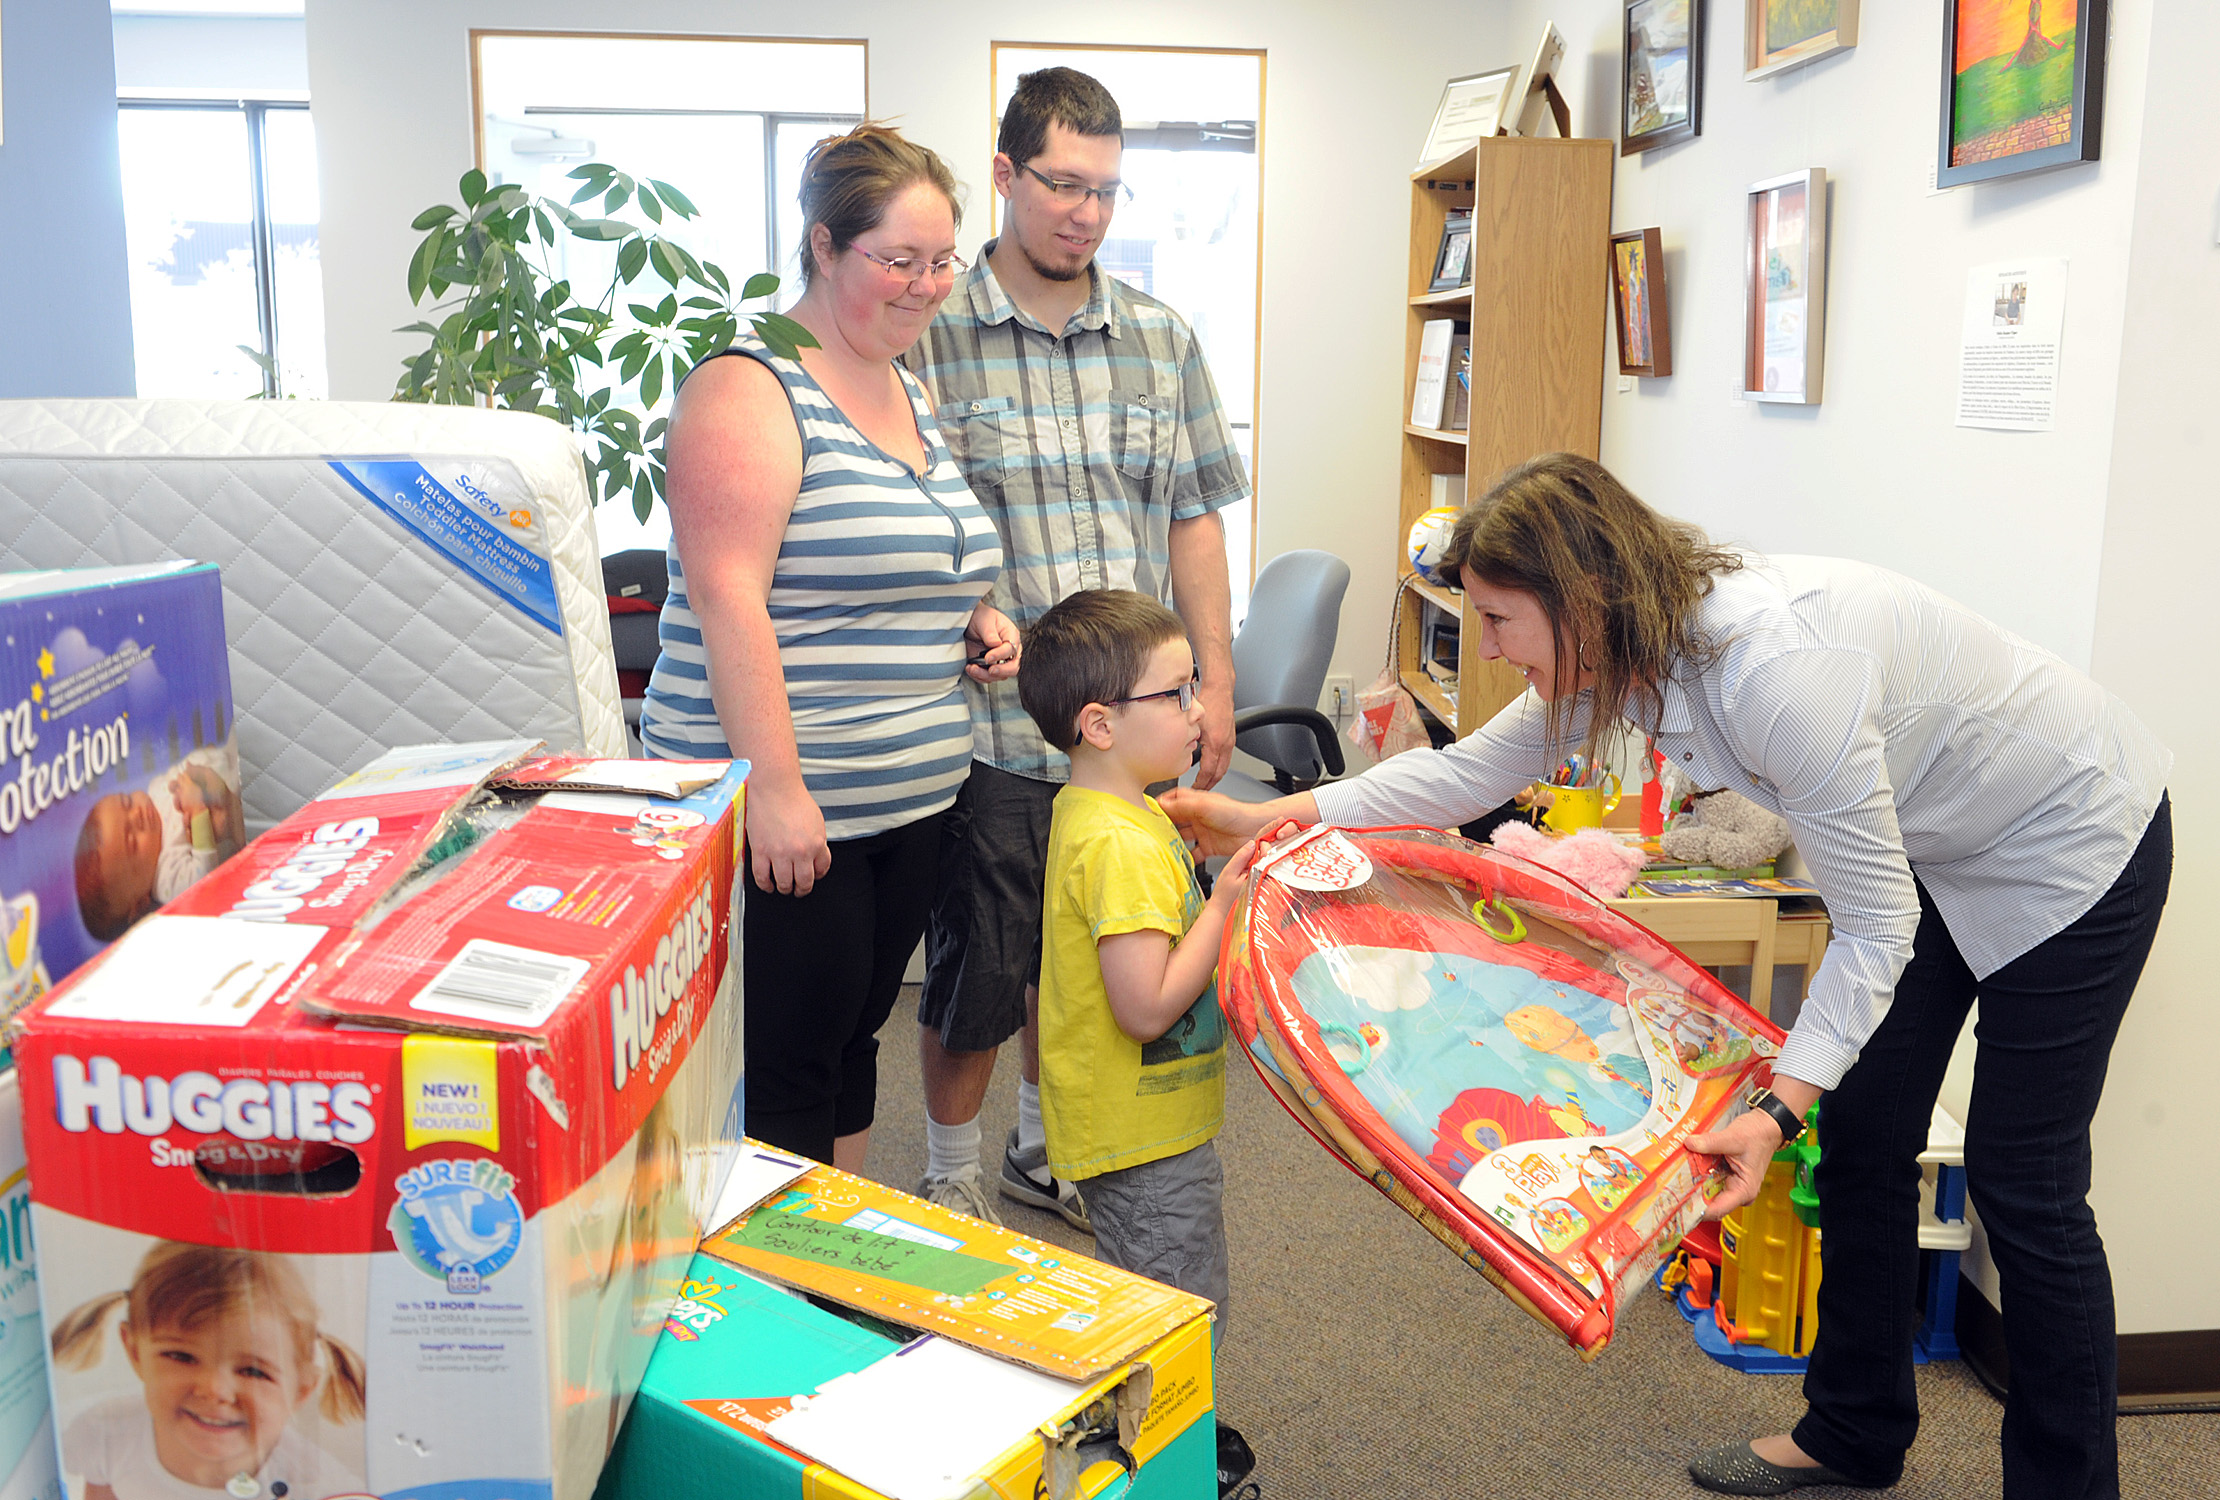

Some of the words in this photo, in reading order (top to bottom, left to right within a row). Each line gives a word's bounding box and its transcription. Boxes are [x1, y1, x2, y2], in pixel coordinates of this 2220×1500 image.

[455, 474, 509, 517] Safety
[394, 492, 445, 537] Colchón
[444, 534, 474, 557] para
[475, 554, 527, 594] chiquillo
[415, 474, 462, 518] Matelas
[463, 512, 494, 541] pour
[494, 535, 541, 573] bambin
[419, 494, 467, 536] Toddler
[468, 531, 521, 574] Mattress
[0, 699, 39, 765] ra
[0, 716, 129, 834] otection
[610, 879, 714, 1092] HUGGIES
[53, 1054, 376, 1144] HUGGIES
[315, 1070, 365, 1081] COUCHES
[763, 1233, 842, 1259] Souliers
[765, 1215, 838, 1237] Contour
[842, 1231, 864, 1245] de
[440, 1301, 475, 1310] HOUR
[672, 1299, 724, 1329] ers
[717, 1401, 746, 1419] 172
